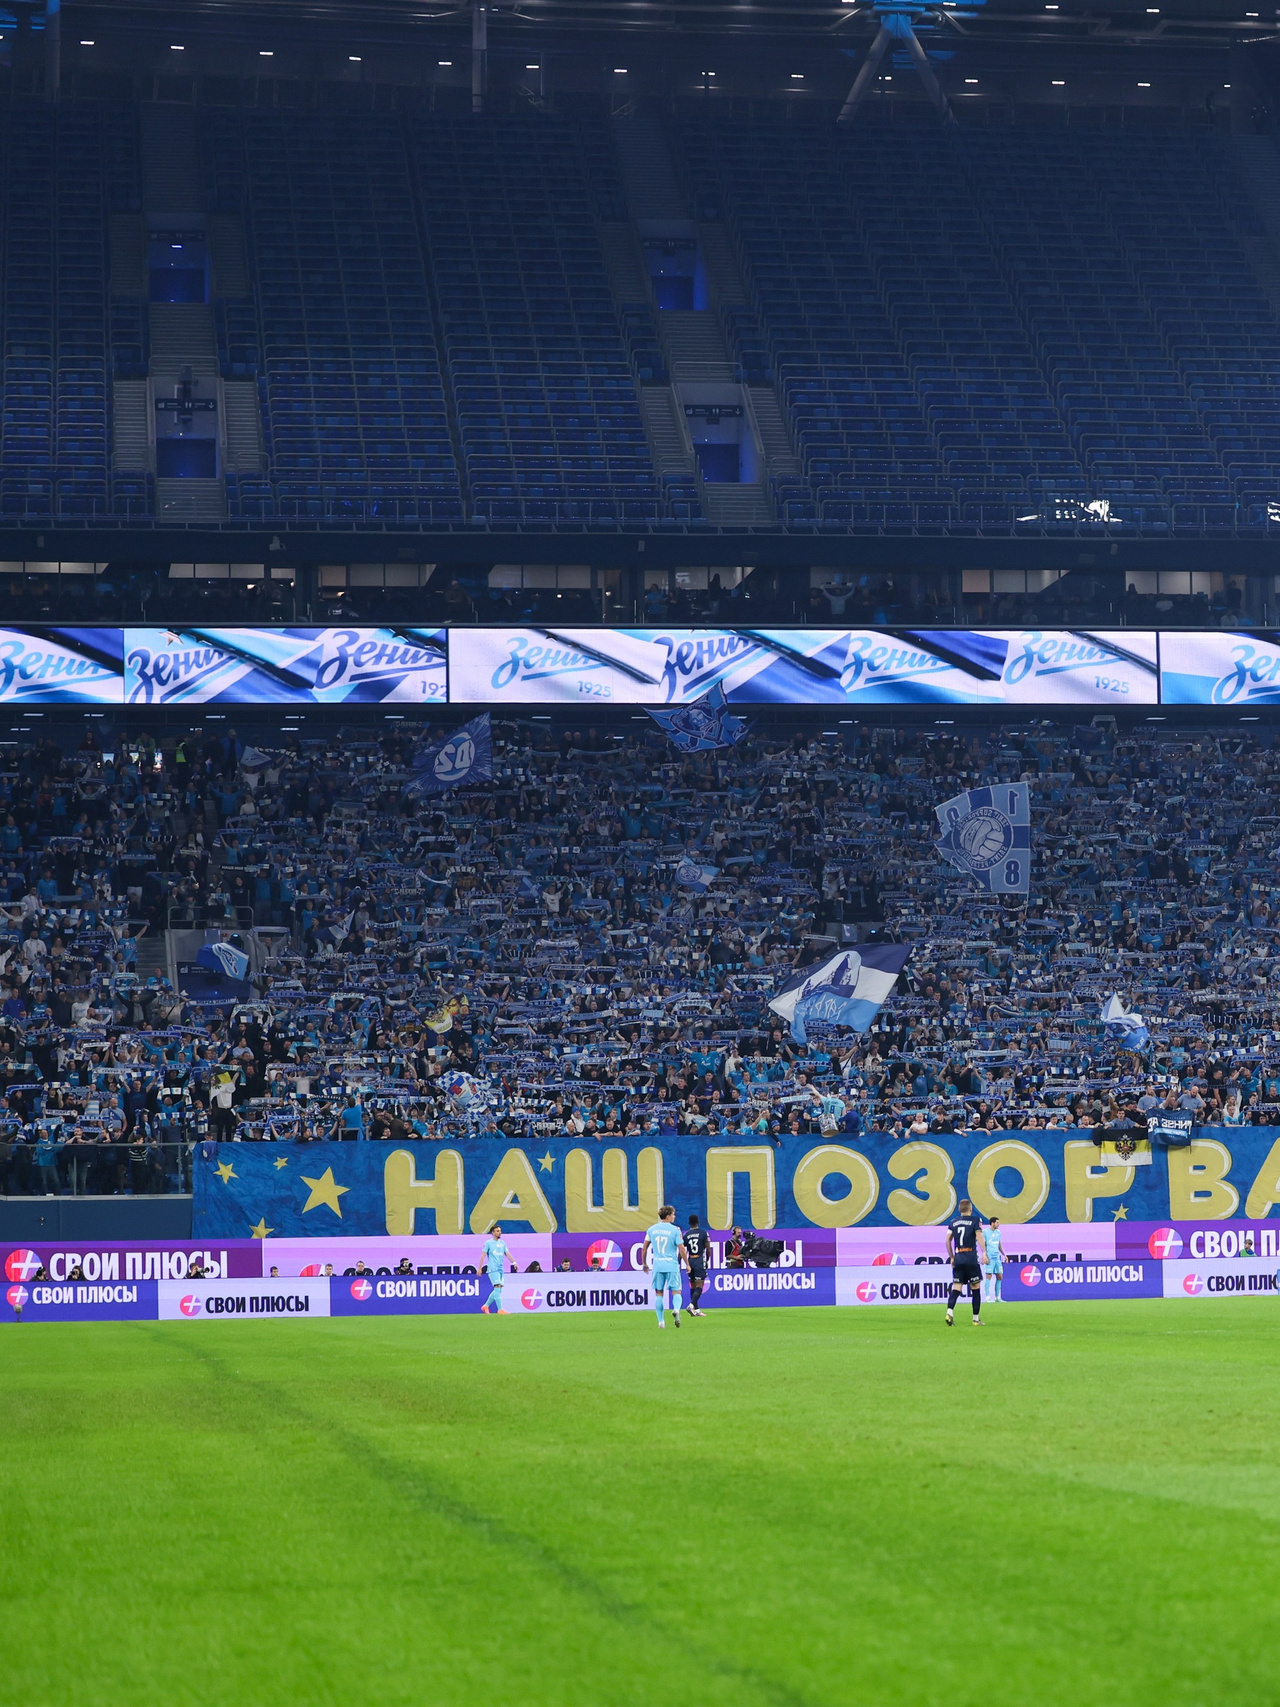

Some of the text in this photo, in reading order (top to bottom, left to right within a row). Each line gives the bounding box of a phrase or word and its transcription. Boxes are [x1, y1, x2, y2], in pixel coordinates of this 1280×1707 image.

[578, 680, 612, 697] 1925
[1094, 676, 1129, 694] 1925
[383, 1147, 665, 1235] НАШ
[705, 1138, 1134, 1232] ПОЗОР
[655, 1235, 668, 1254] 17
[957, 1226, 966, 1246] 7
[1189, 1229, 1254, 1258] СВОИ
[688, 1238, 699, 1254] 13
[50, 1252, 119, 1282] СВОИ
[1044, 1265, 1144, 1284] СВОИ ПЛЮСЫ
[376, 1279, 480, 1299] СВОИ ПЛЮСЫ
[714, 1272, 816, 1292] СВОИ ПЛЮСЫ
[881, 1283, 919, 1300] СВОИ
[1207, 1275, 1245, 1292] СВОИ
[32, 1285, 137, 1305] СВОИ ПЛЮСЫ
[205, 1294, 310, 1314] СВОИ ПЛЮСЫ
[546, 1288, 649, 1307] СВОИ ПЛЮСЫ
